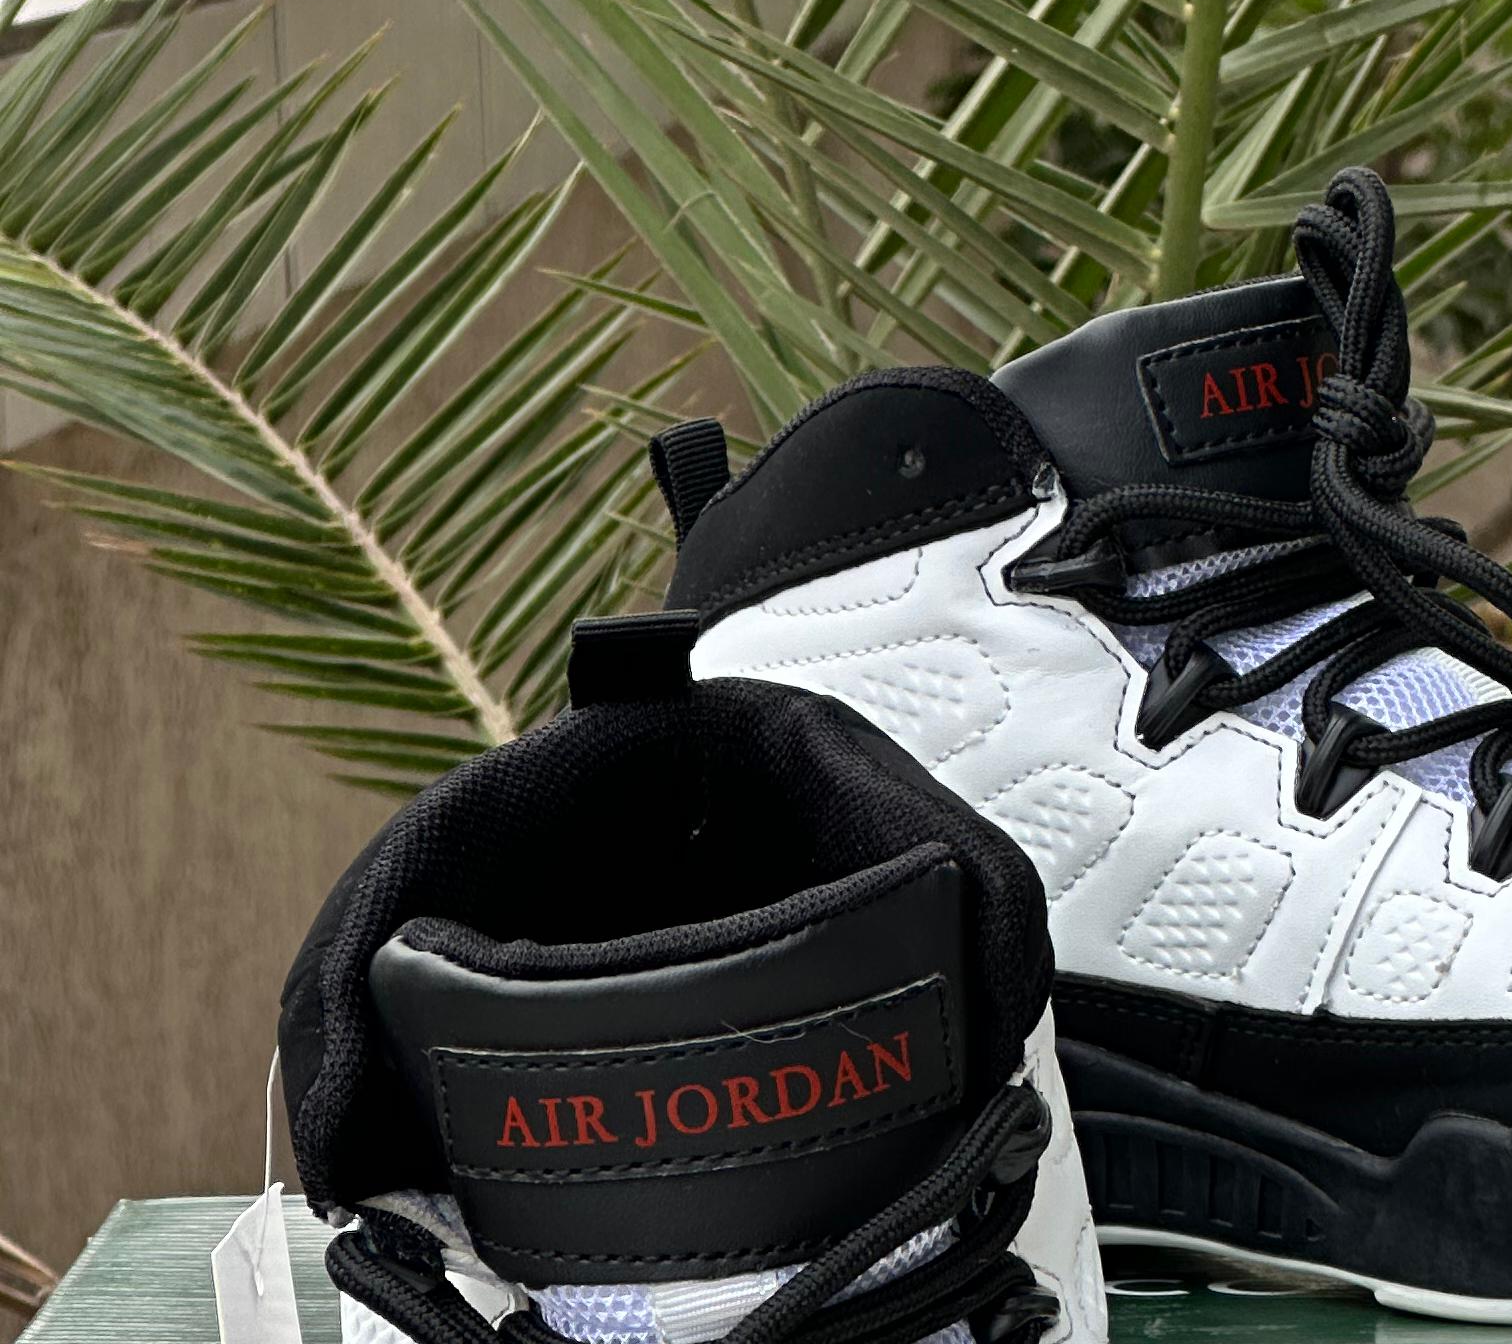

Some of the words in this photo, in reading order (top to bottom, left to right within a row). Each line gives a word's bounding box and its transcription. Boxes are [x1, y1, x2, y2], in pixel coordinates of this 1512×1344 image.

[1200, 362, 1289, 420] AIR
[496, 1094, 619, 1149] AIR
[634, 1031, 913, 1149] JORDAN
